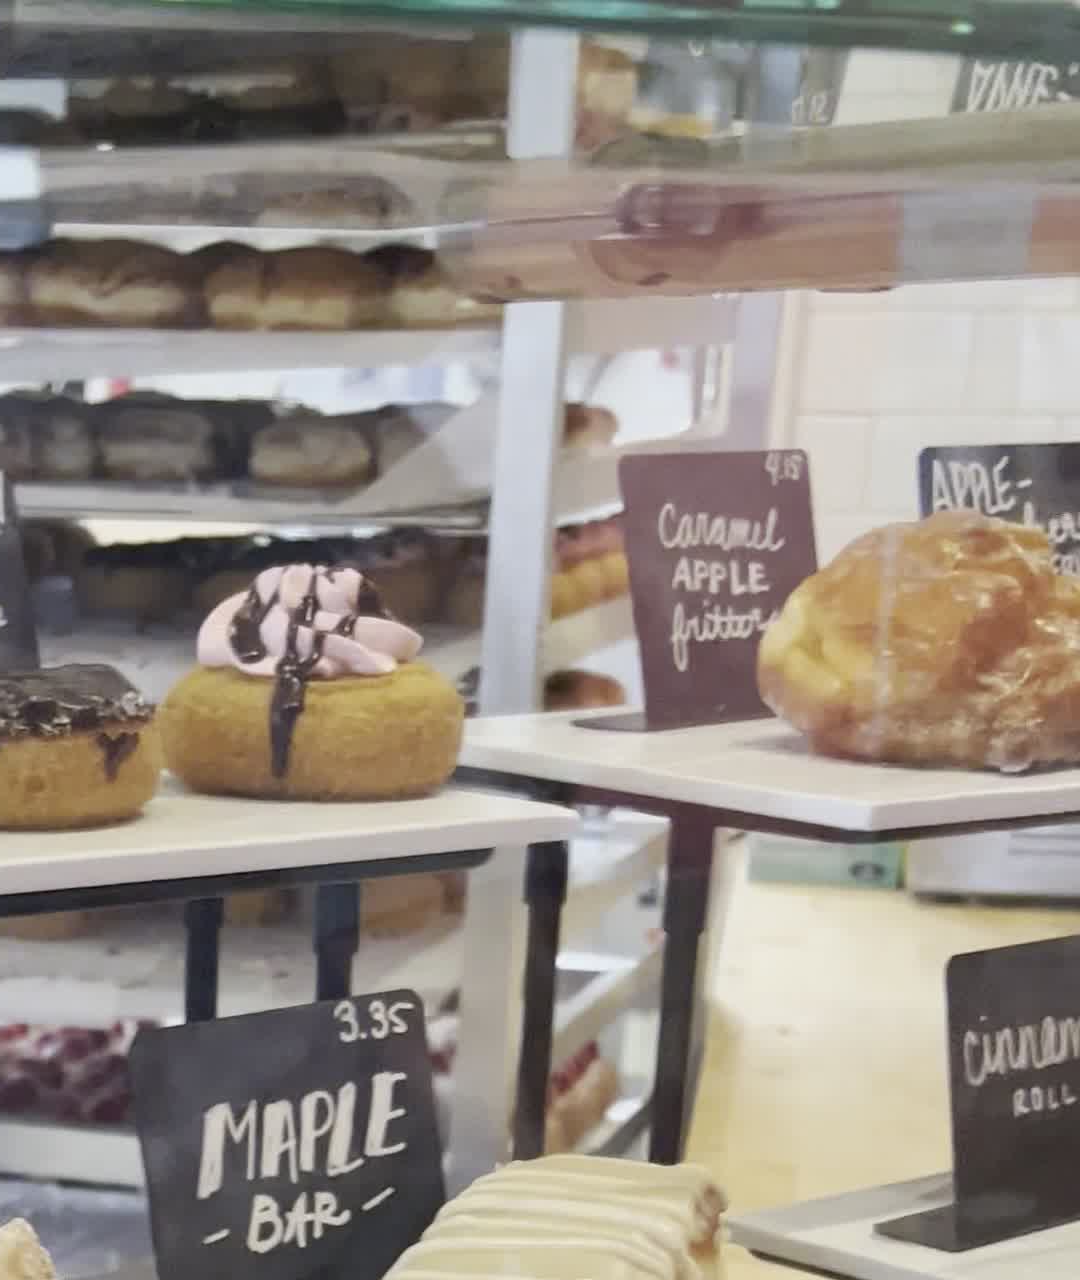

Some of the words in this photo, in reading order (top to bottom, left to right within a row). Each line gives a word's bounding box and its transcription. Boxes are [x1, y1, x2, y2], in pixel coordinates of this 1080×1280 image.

[671, 559, 771, 595] APPLE
[334, 1000, 416, 1043] 3.35
[1013, 1084, 1077, 1118] ROLL
[197, 1072, 407, 1200] MAPLE
[246, 1191, 352, 1255] BAR
